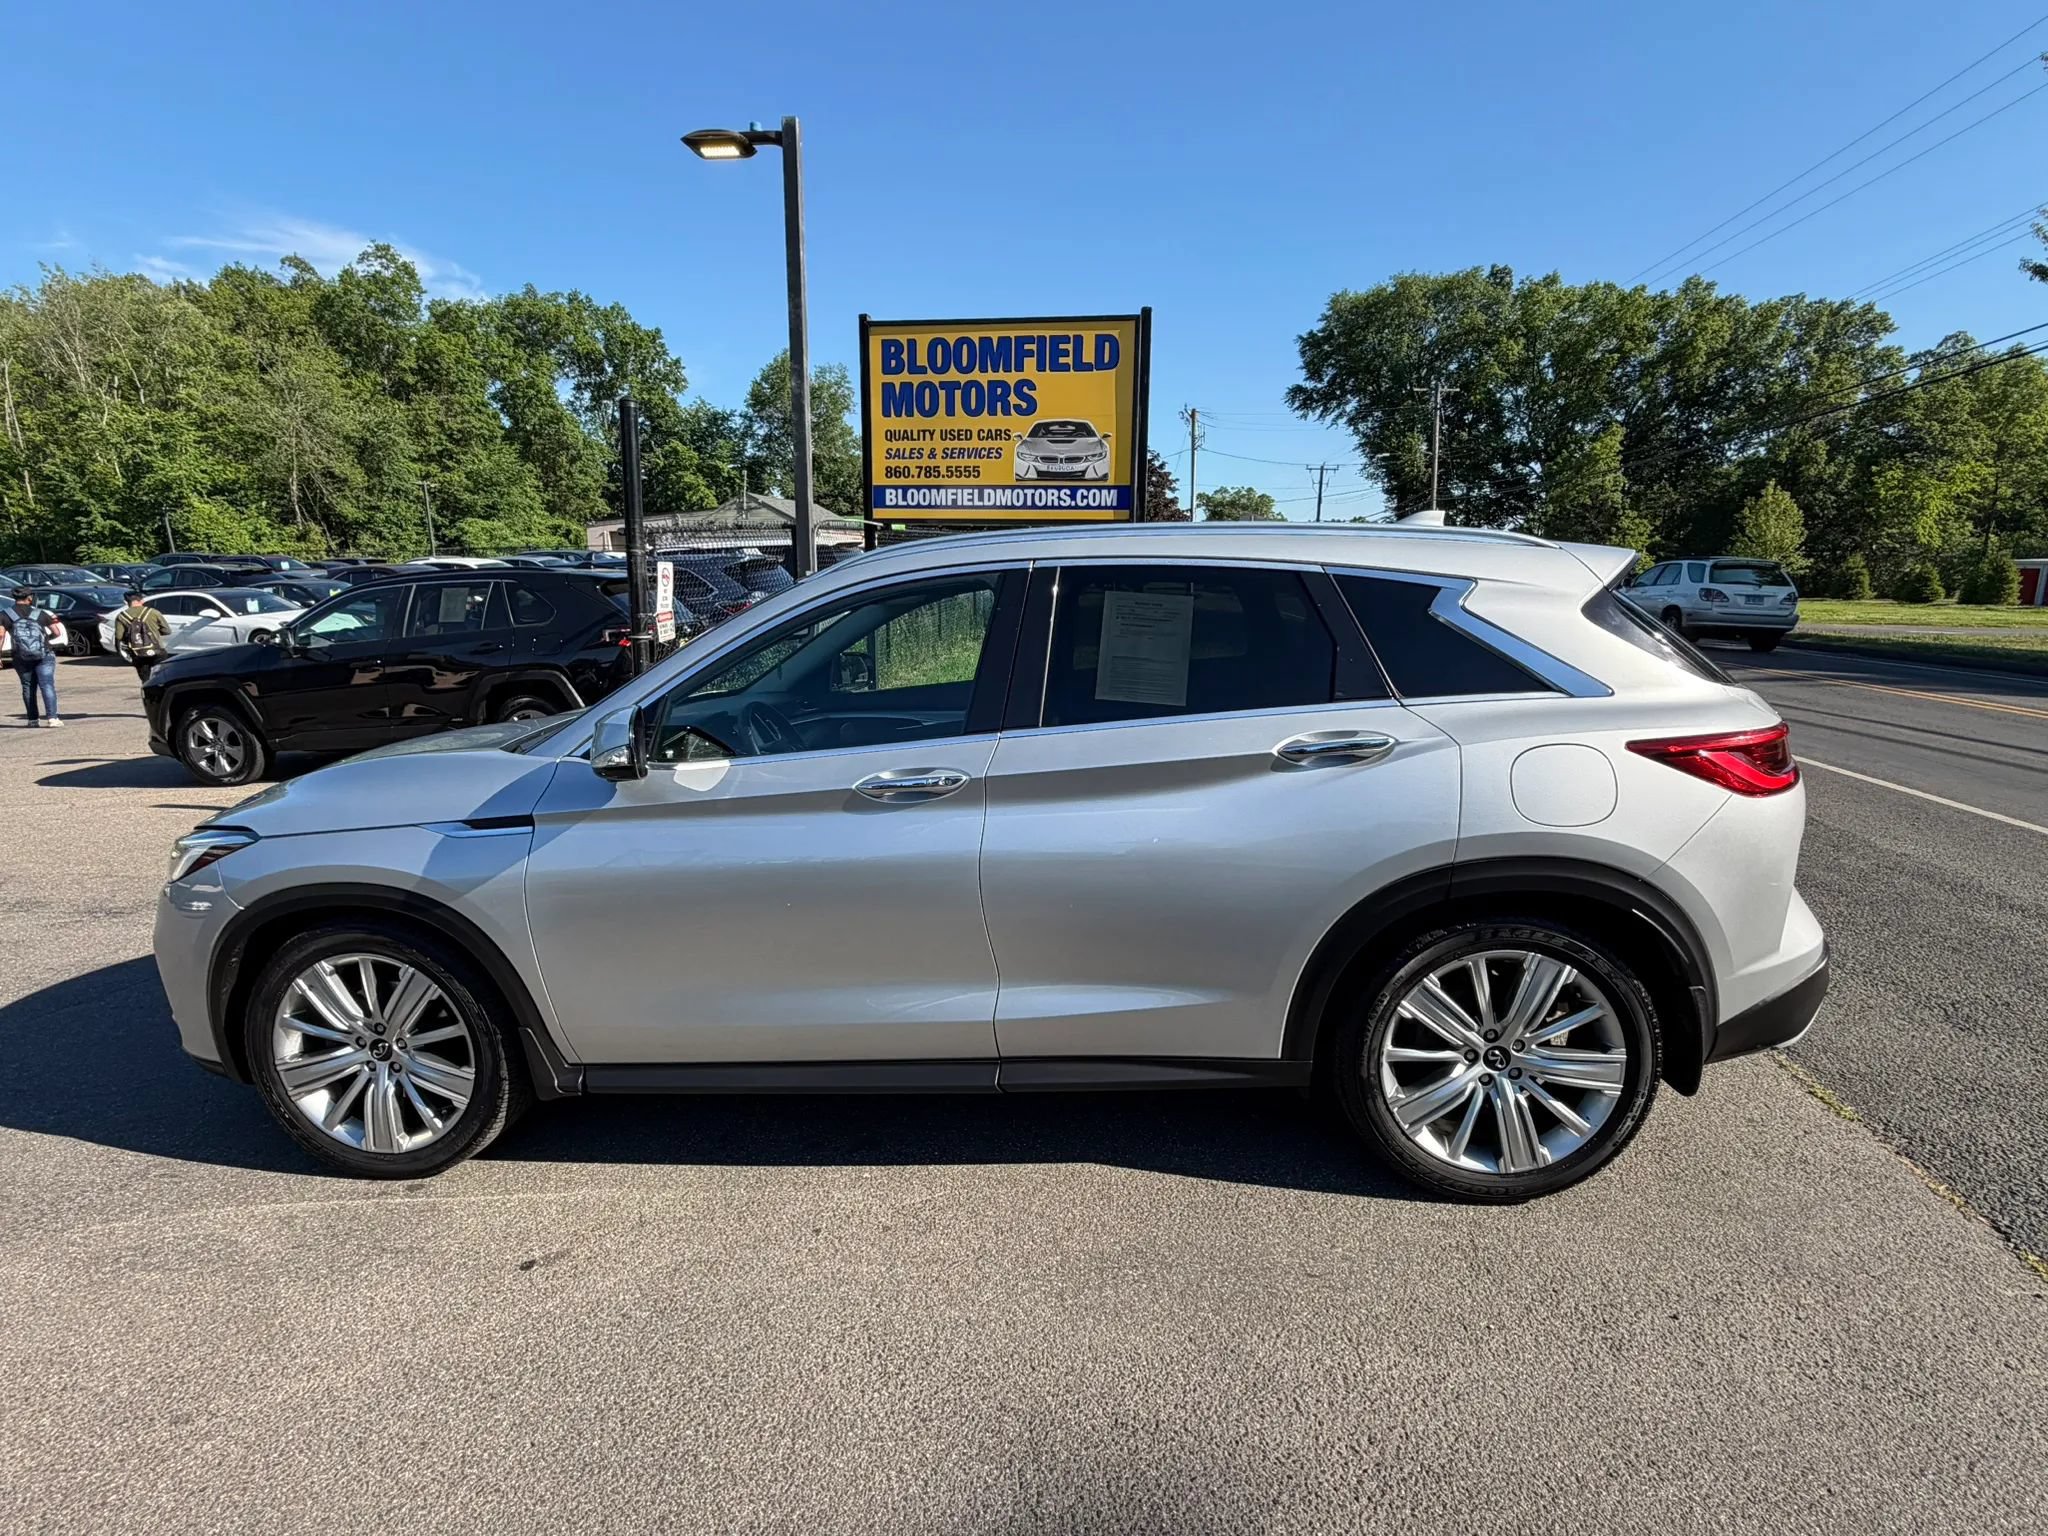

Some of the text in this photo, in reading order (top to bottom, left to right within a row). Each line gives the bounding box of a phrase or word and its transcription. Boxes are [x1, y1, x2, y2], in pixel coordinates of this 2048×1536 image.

[881, 333, 1120, 375] BLOOMFIELD
[881, 379, 1038, 417] MOTORS
[885, 428, 1012, 442] QUALITY USED CARS
[885, 446, 1003, 460] SALES & SERVICES
[885, 465, 981, 479] 860.785.5555
[885, 488, 1118, 506] BLOOMFIELDMOTORS.COM
